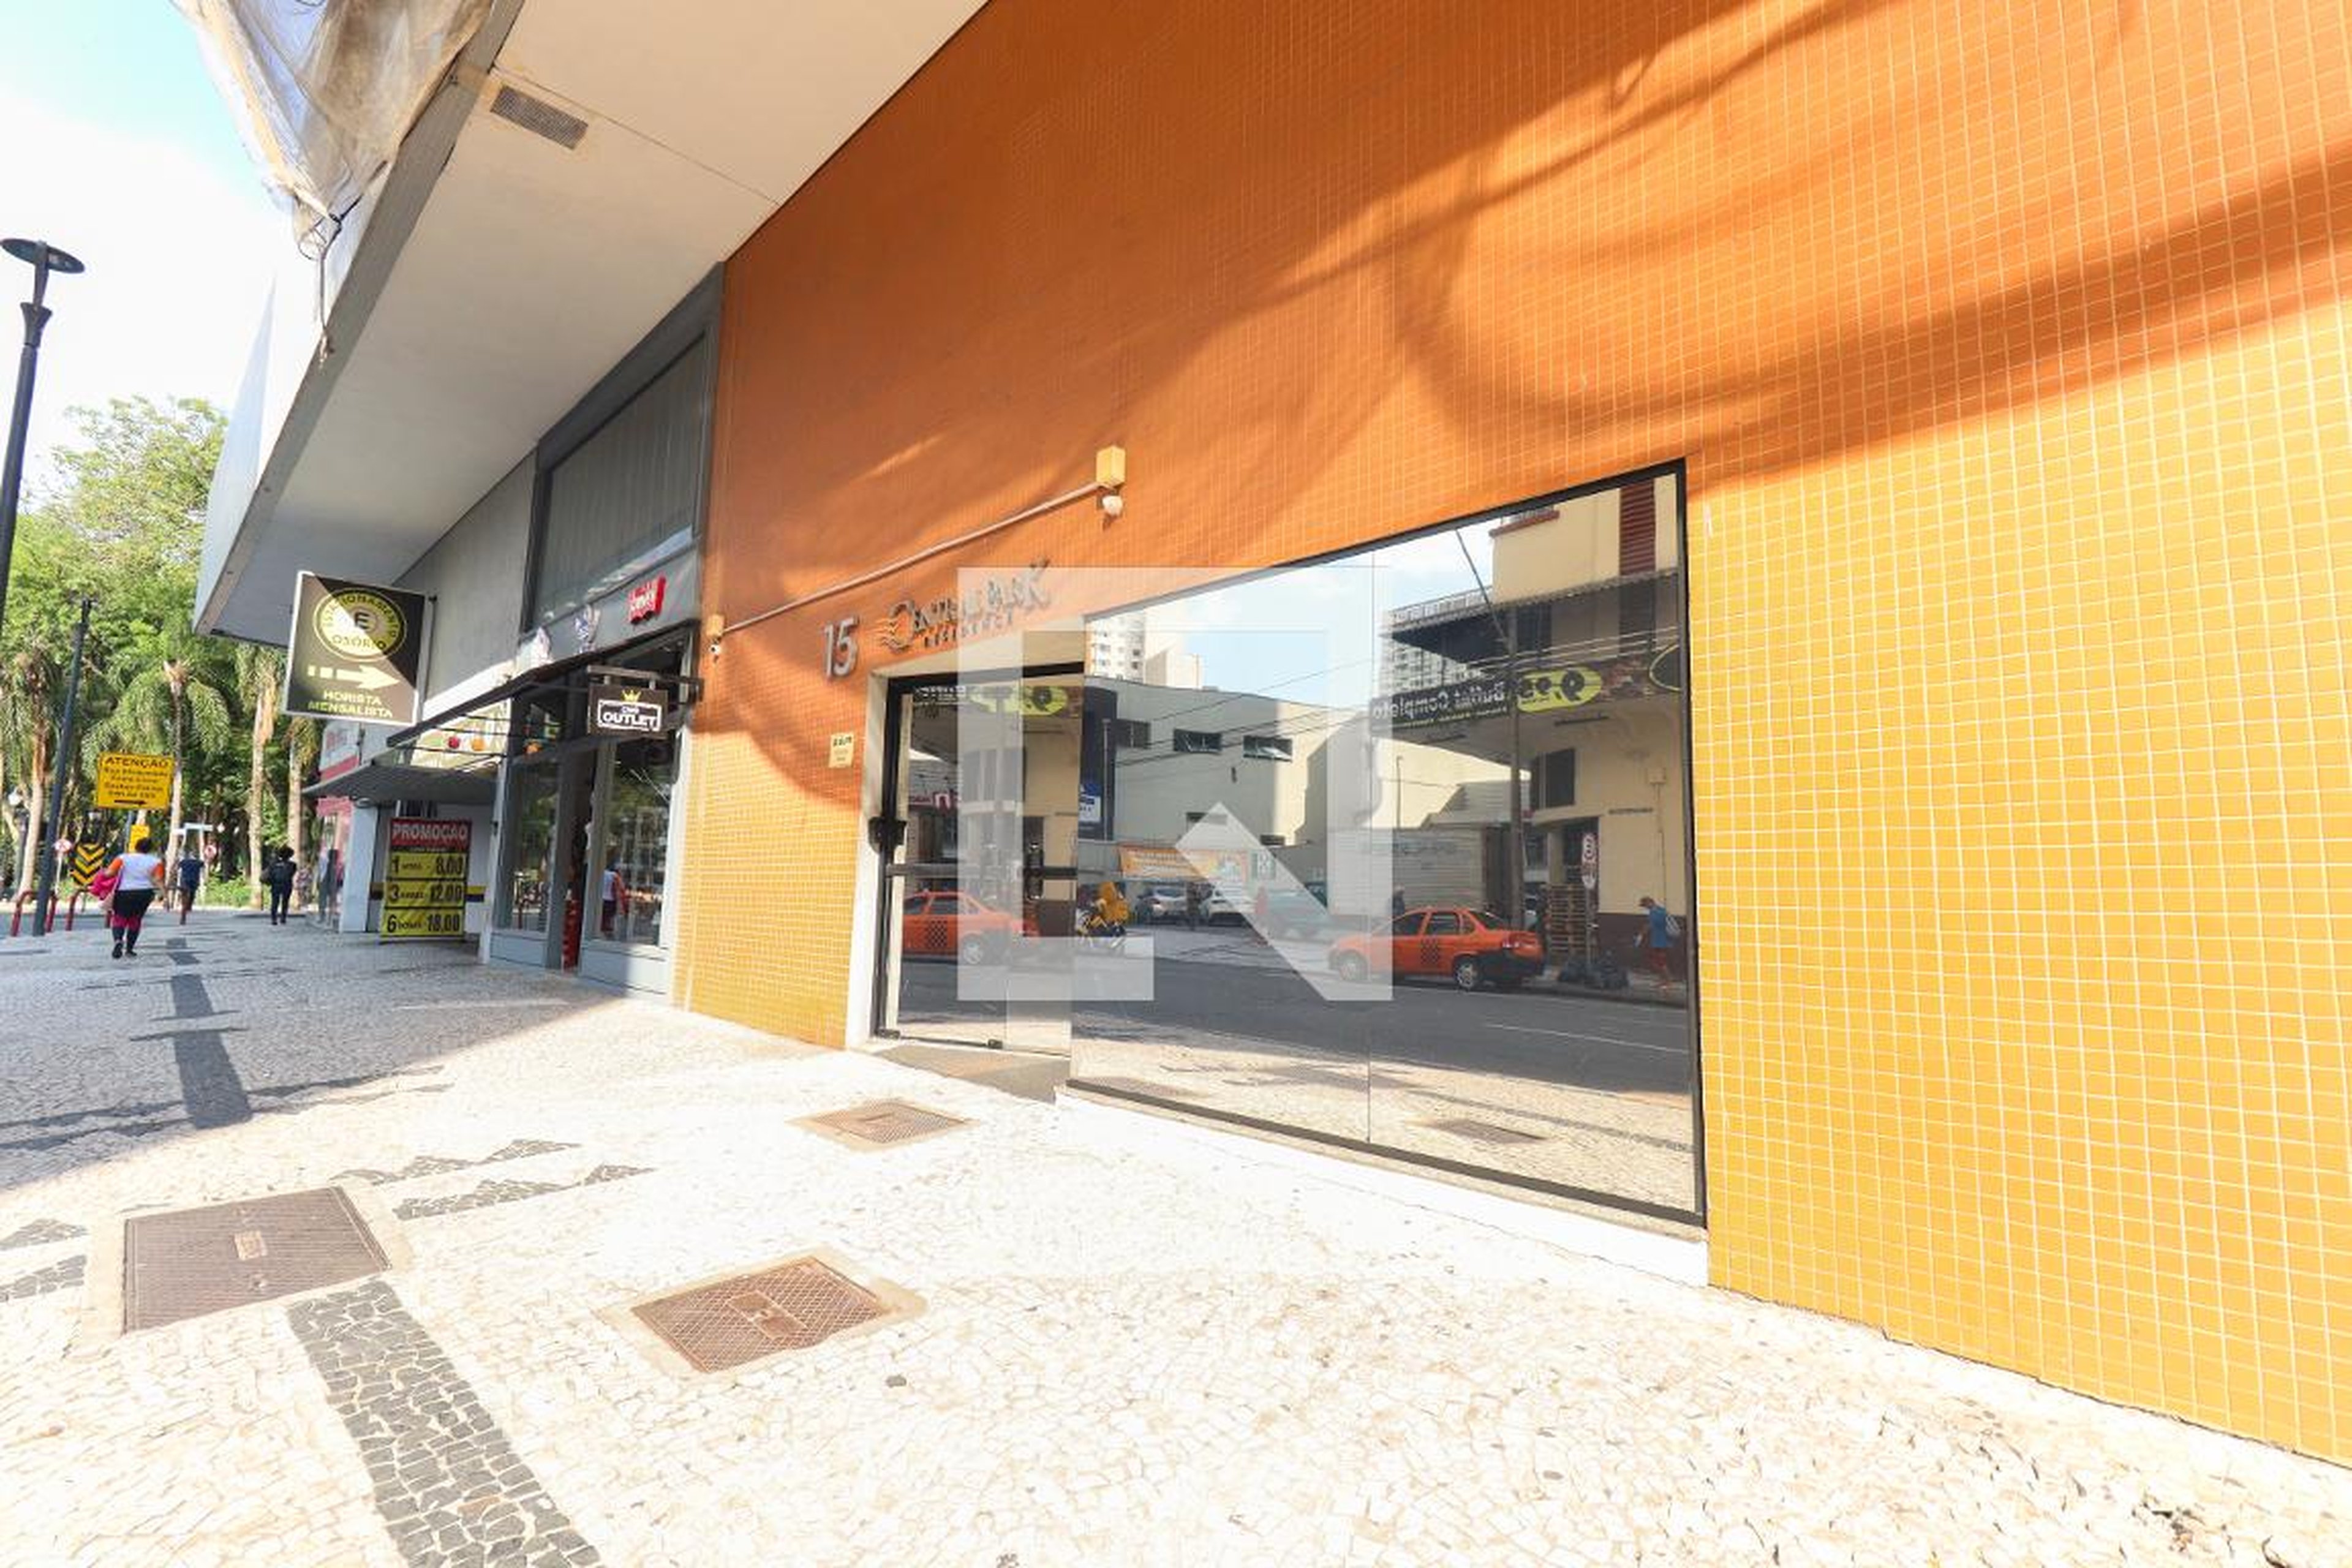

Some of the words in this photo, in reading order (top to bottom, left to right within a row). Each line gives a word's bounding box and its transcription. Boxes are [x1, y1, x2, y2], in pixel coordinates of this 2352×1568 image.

[823, 615, 858, 679] 15
[323, 690, 382, 706] HORISTA
[307, 701, 393, 718] MENSALISTA
[602, 712, 656, 728] OUTLET
[392, 823, 468, 842] PROMOÇÃO
[393, 855, 400, 874] 1
[435, 857, 464, 876] 8,00
[389, 884, 400, 902] 3
[386, 914, 398, 933] 6
